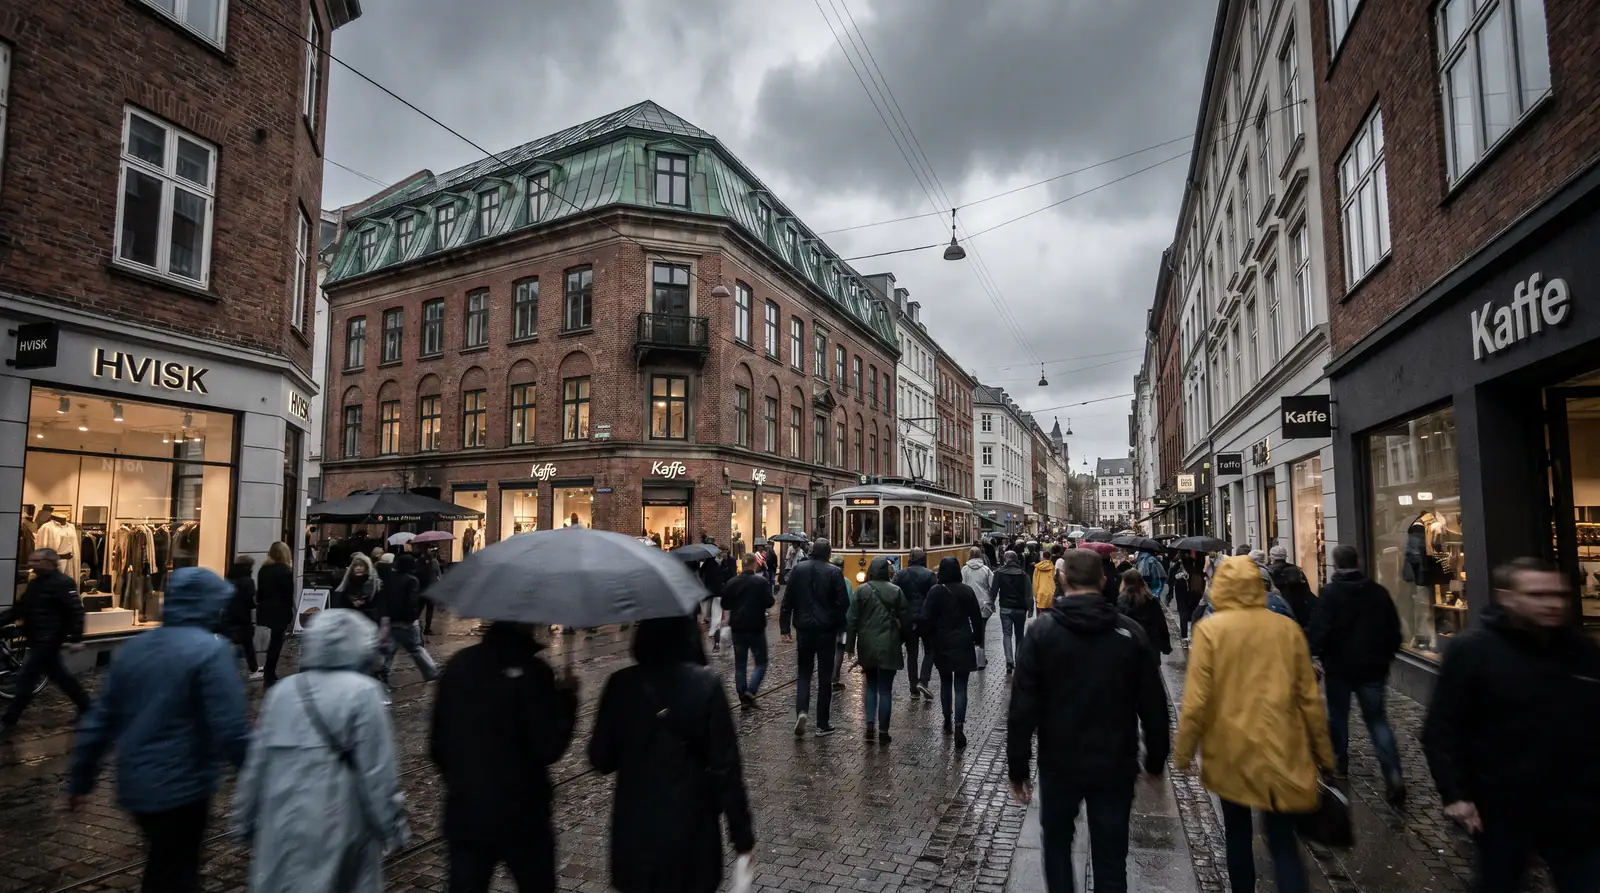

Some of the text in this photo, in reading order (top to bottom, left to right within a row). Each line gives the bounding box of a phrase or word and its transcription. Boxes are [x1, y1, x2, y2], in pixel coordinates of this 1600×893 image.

[1470, 271, 1571, 361] Kaffe
[20, 338, 48, 351] HVISK
[93, 347, 209, 394] HVISK
[1285, 410, 1327, 424] Kaffe
[530, 462, 557, 481] Kaffe
[651, 460, 687, 479] Kaffe
[751, 468, 767, 486] Kaffe
